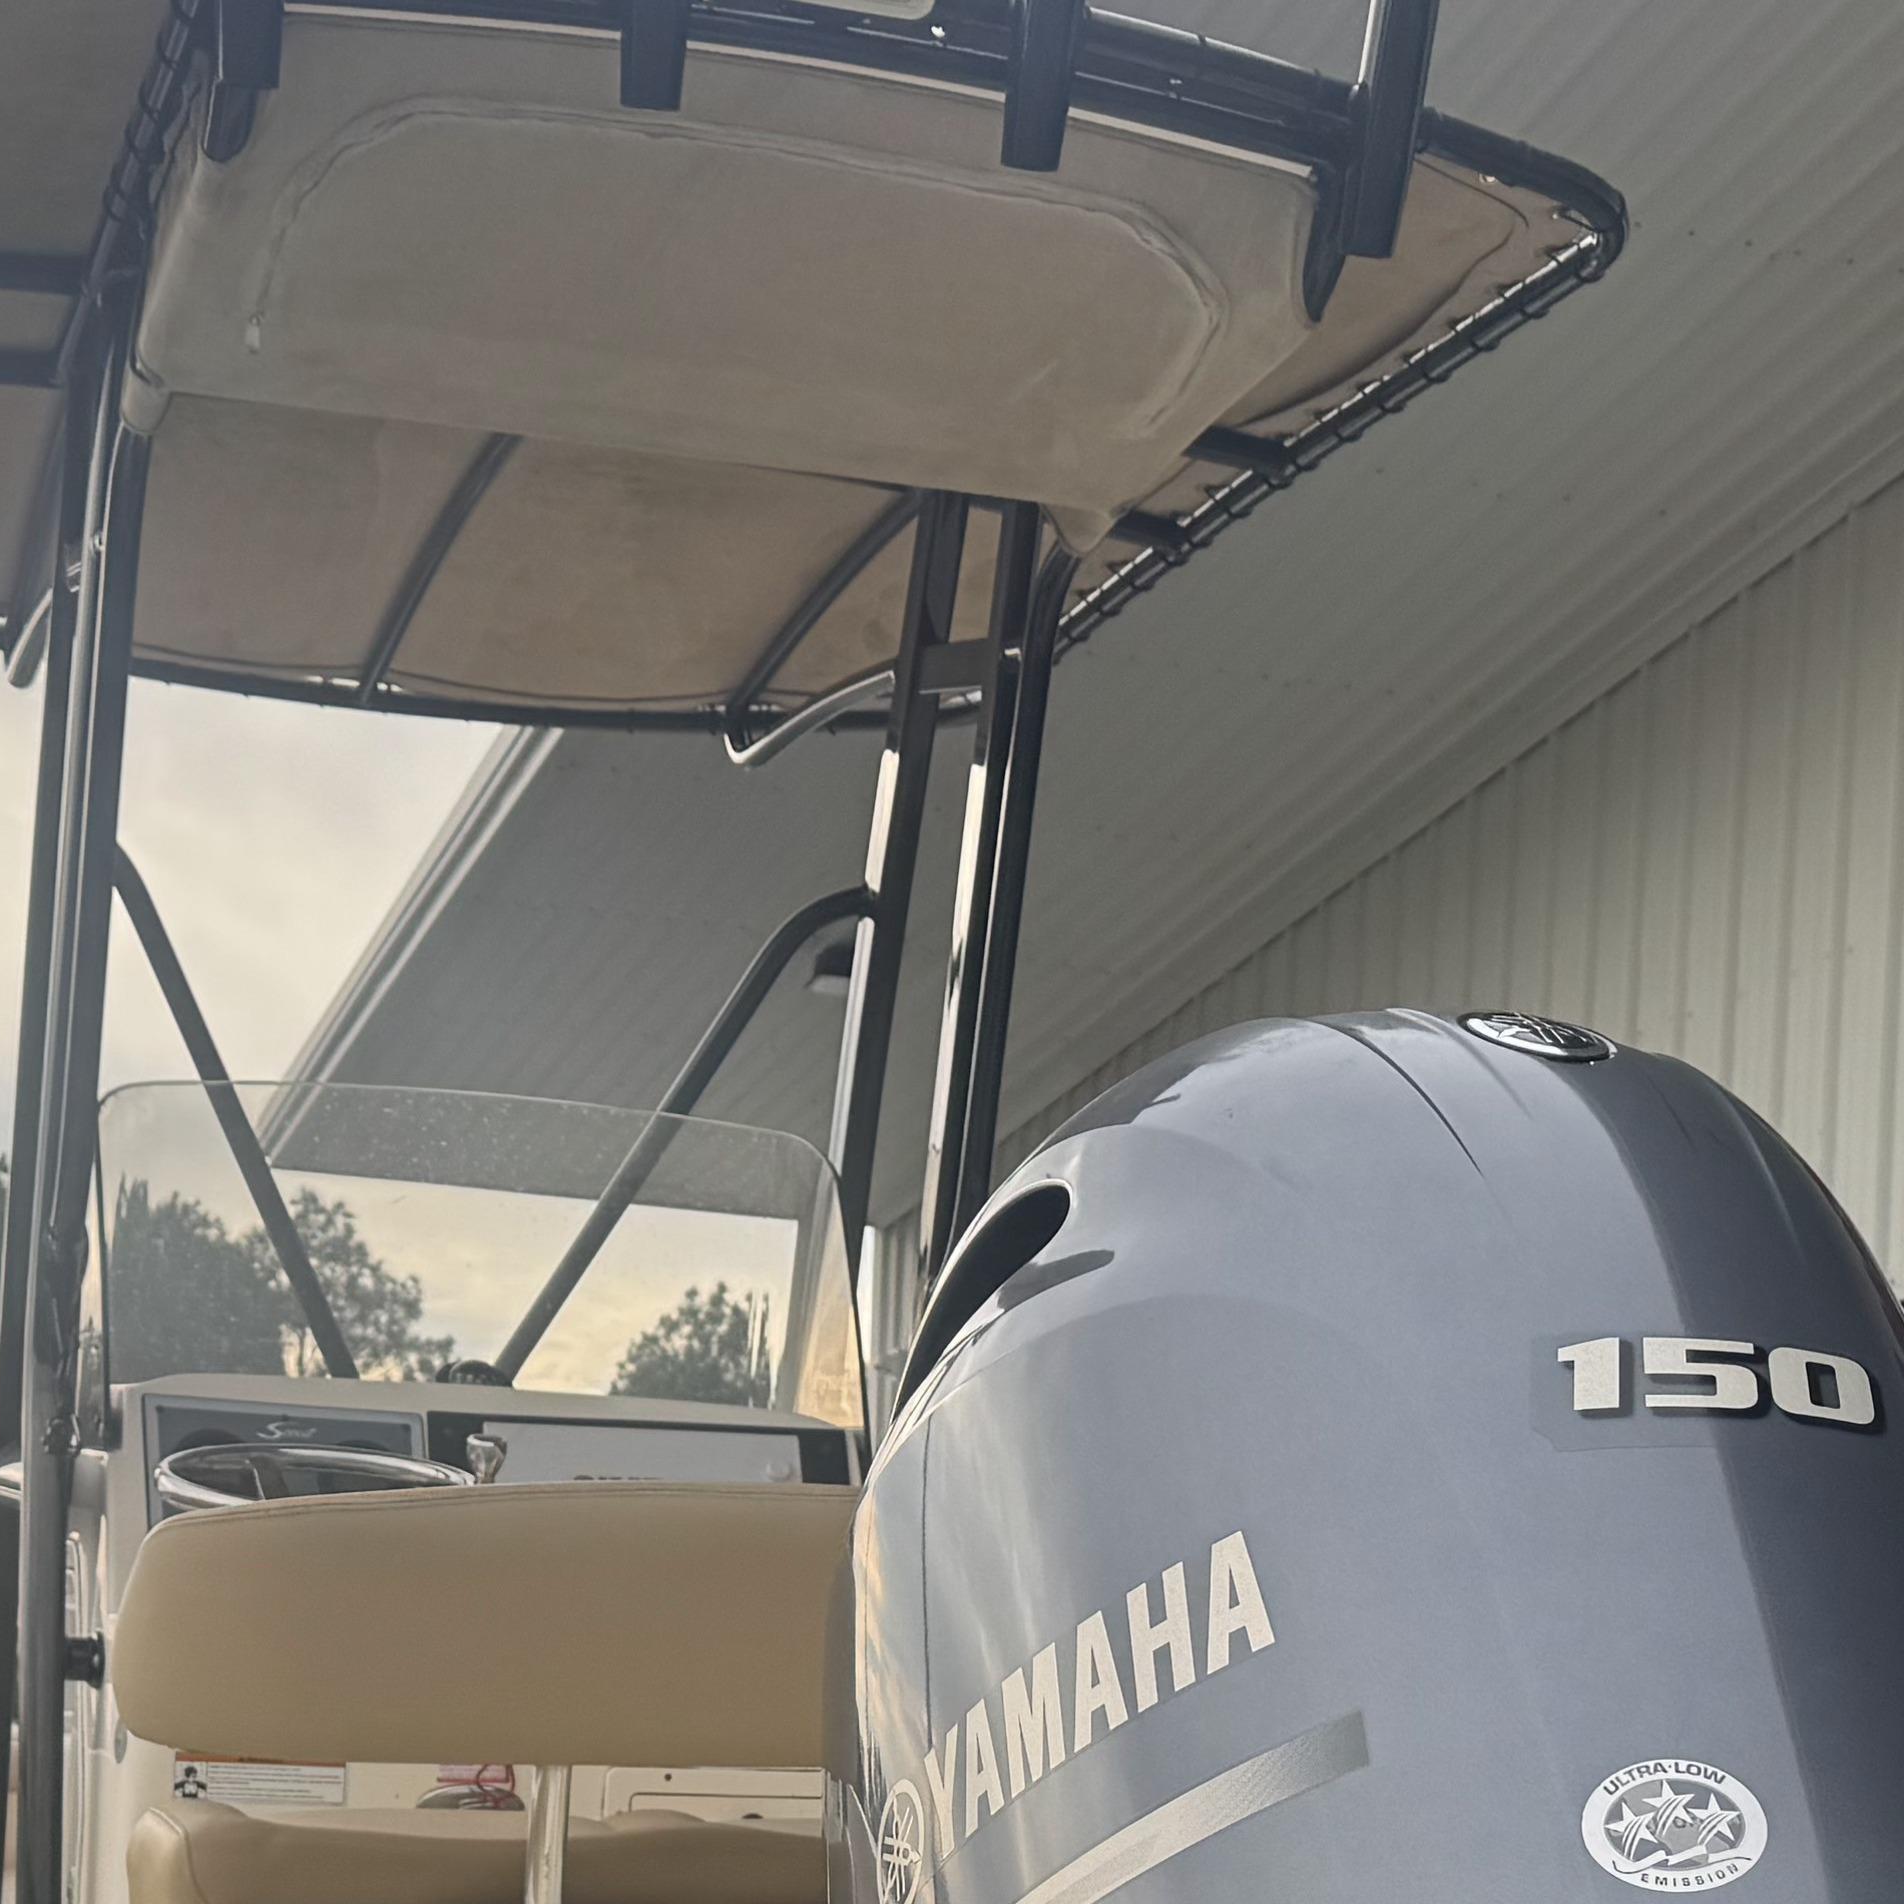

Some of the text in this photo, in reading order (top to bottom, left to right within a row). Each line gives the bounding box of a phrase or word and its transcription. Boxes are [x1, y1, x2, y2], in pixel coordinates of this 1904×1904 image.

[1556, 1335, 1877, 1427] 150
[922, 1530, 1276, 1860] YAMAHA
[1641, 1863, 1739, 1887] EMISSION
